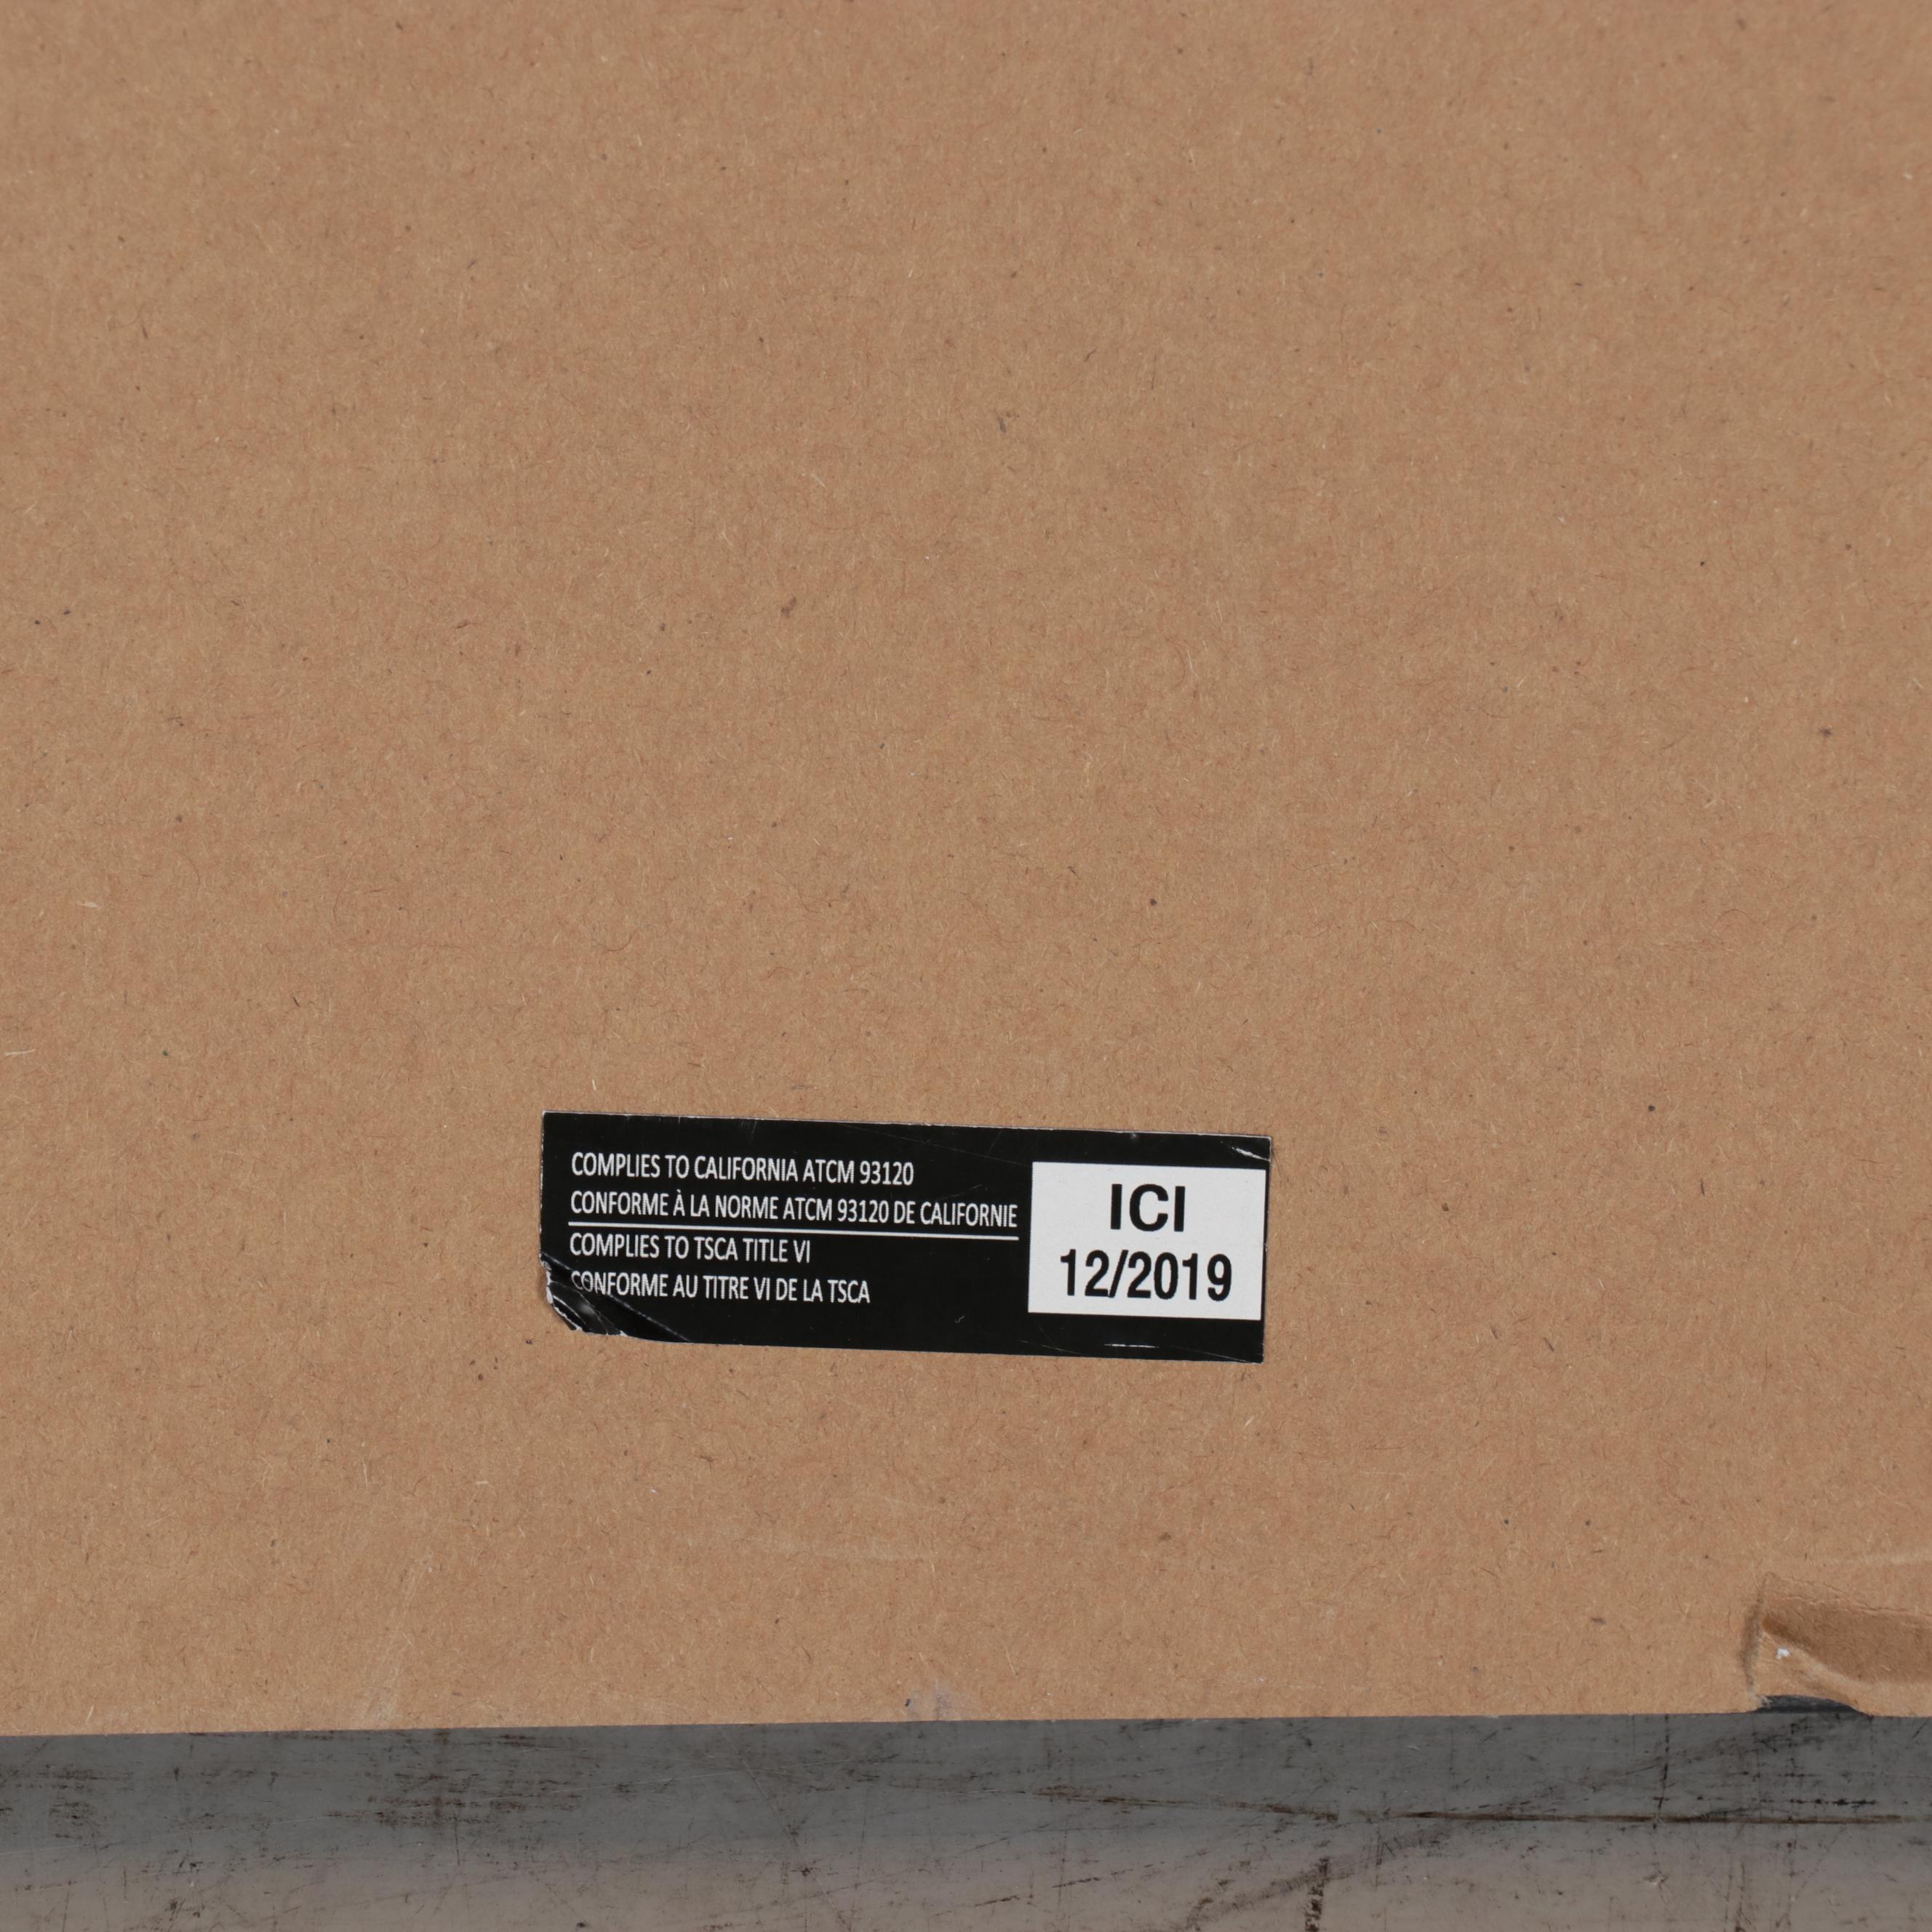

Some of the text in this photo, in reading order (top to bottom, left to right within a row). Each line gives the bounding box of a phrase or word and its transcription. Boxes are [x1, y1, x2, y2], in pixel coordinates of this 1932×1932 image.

[571, 1151, 914, 1186] COMPLIES TO CALIFORNIA ATCM 93120
[570, 1189, 1018, 1228] CONFORME À LA NORME ATCM 93120 DE CALIFORNIE
[1110, 1183, 1186, 1232] ICI
[570, 1232, 810, 1264] COMPLIES TO TSCA TITLE VI
[571, 1270, 871, 1304] CONFORME AU TITRE VI DE LA TSCA
[1060, 1248, 1232, 1301] 12/2019
